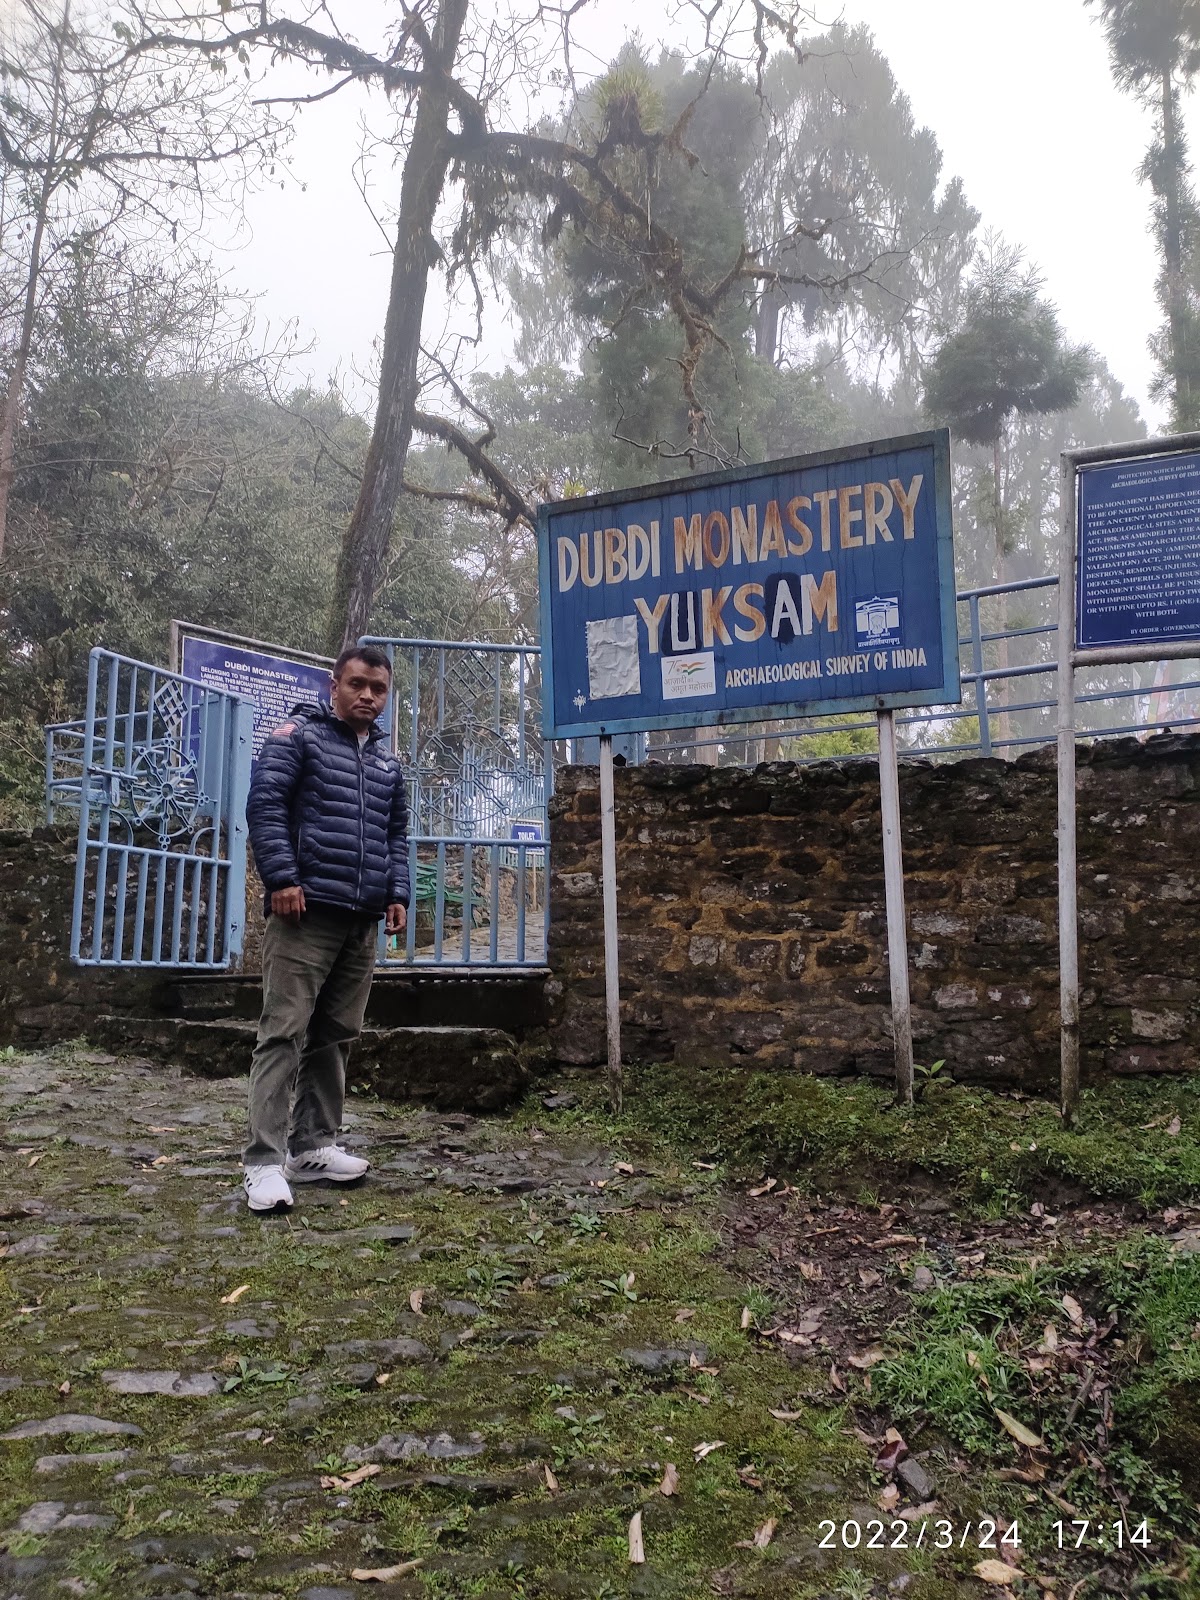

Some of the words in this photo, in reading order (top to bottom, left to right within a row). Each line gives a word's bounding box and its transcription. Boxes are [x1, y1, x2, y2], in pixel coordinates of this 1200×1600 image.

[1117, 471, 1152, 480] PROTECTION
[1153, 467, 1175, 475] NOTICE
[1110, 477, 1157, 489] ARCHAEOLOGICAL
[1158, 474, 1178, 482] SURVEY
[1105, 496, 1148, 508] MONUMENT
[1119, 505, 1154, 515] NATIONAL
[1087, 520, 1105, 528] THE
[1106, 514, 1146, 525] ANCIENT
[1087, 522, 1154, 537] ARCHAEOLOGICAL
[1155, 519, 1176, 527] SITES
[1177, 517, 1193, 525] AND
[557, 520, 660, 593] DUBDI
[674, 473, 924, 574] MONASTERY
[1130, 530, 1166, 540] AMENDED
[1087, 542, 1135, 553] MONUMENTS
[1137, 540, 1153, 548] AND
[1087, 554, 1108, 562] SITES
[1127, 547, 1162, 557] REMAINS
[1086, 559, 1139, 570] VALIDATION)
[1123, 575, 1160, 584] IMPERILS
[1087, 586, 1134, 596] MONUMENT
[1135, 583, 1162, 591] SHALL
[1164, 581, 1175, 589] BE
[1107, 592, 1163, 603] IMPRISONMENT
[1118, 603, 1135, 611] FINE
[1174, 598, 1195, 606] (ONE)
[633, 570, 839, 655] YUKSAM
[224, 660, 251, 673] DUBDI
[252, 666, 299, 683] MONASTERY
[725, 658, 823, 689] ARCHAEOLOGICAL
[826, 652, 871, 676] SURVEY
[874, 651, 888, 671] OF
[892, 647, 927, 669] INDIA
[200, 666, 230, 678] BELONGING
[278, 682, 290, 690] SECT
[224, 677, 236, 685] THIS
[236, 680, 265, 691] MONASTERY
[276, 687, 304, 699] ESTABLISHED
